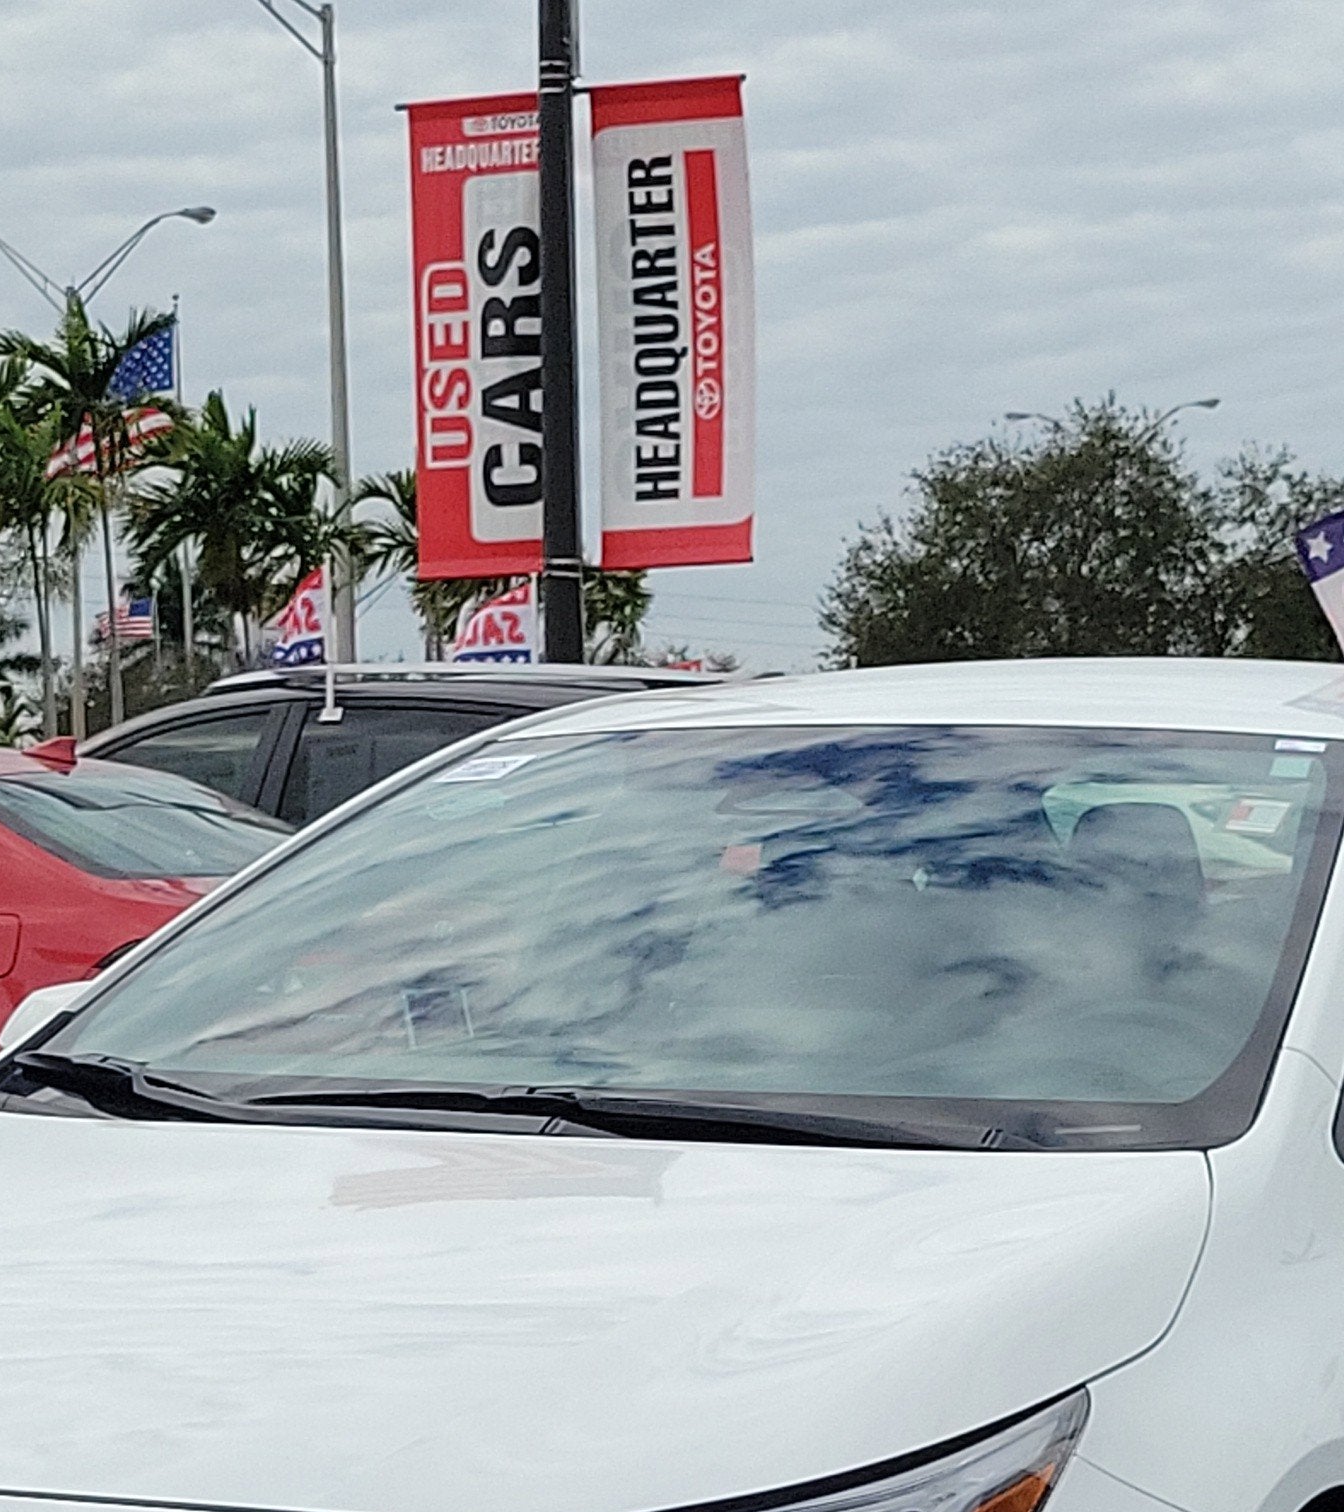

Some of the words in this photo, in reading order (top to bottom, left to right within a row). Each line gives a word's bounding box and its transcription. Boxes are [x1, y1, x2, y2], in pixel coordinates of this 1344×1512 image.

[426, 263, 475, 465] USED
[477, 226, 543, 507] CARS
[628, 154, 688, 502] HEADQUARTER
[695, 243, 719, 377] TOYOTA
